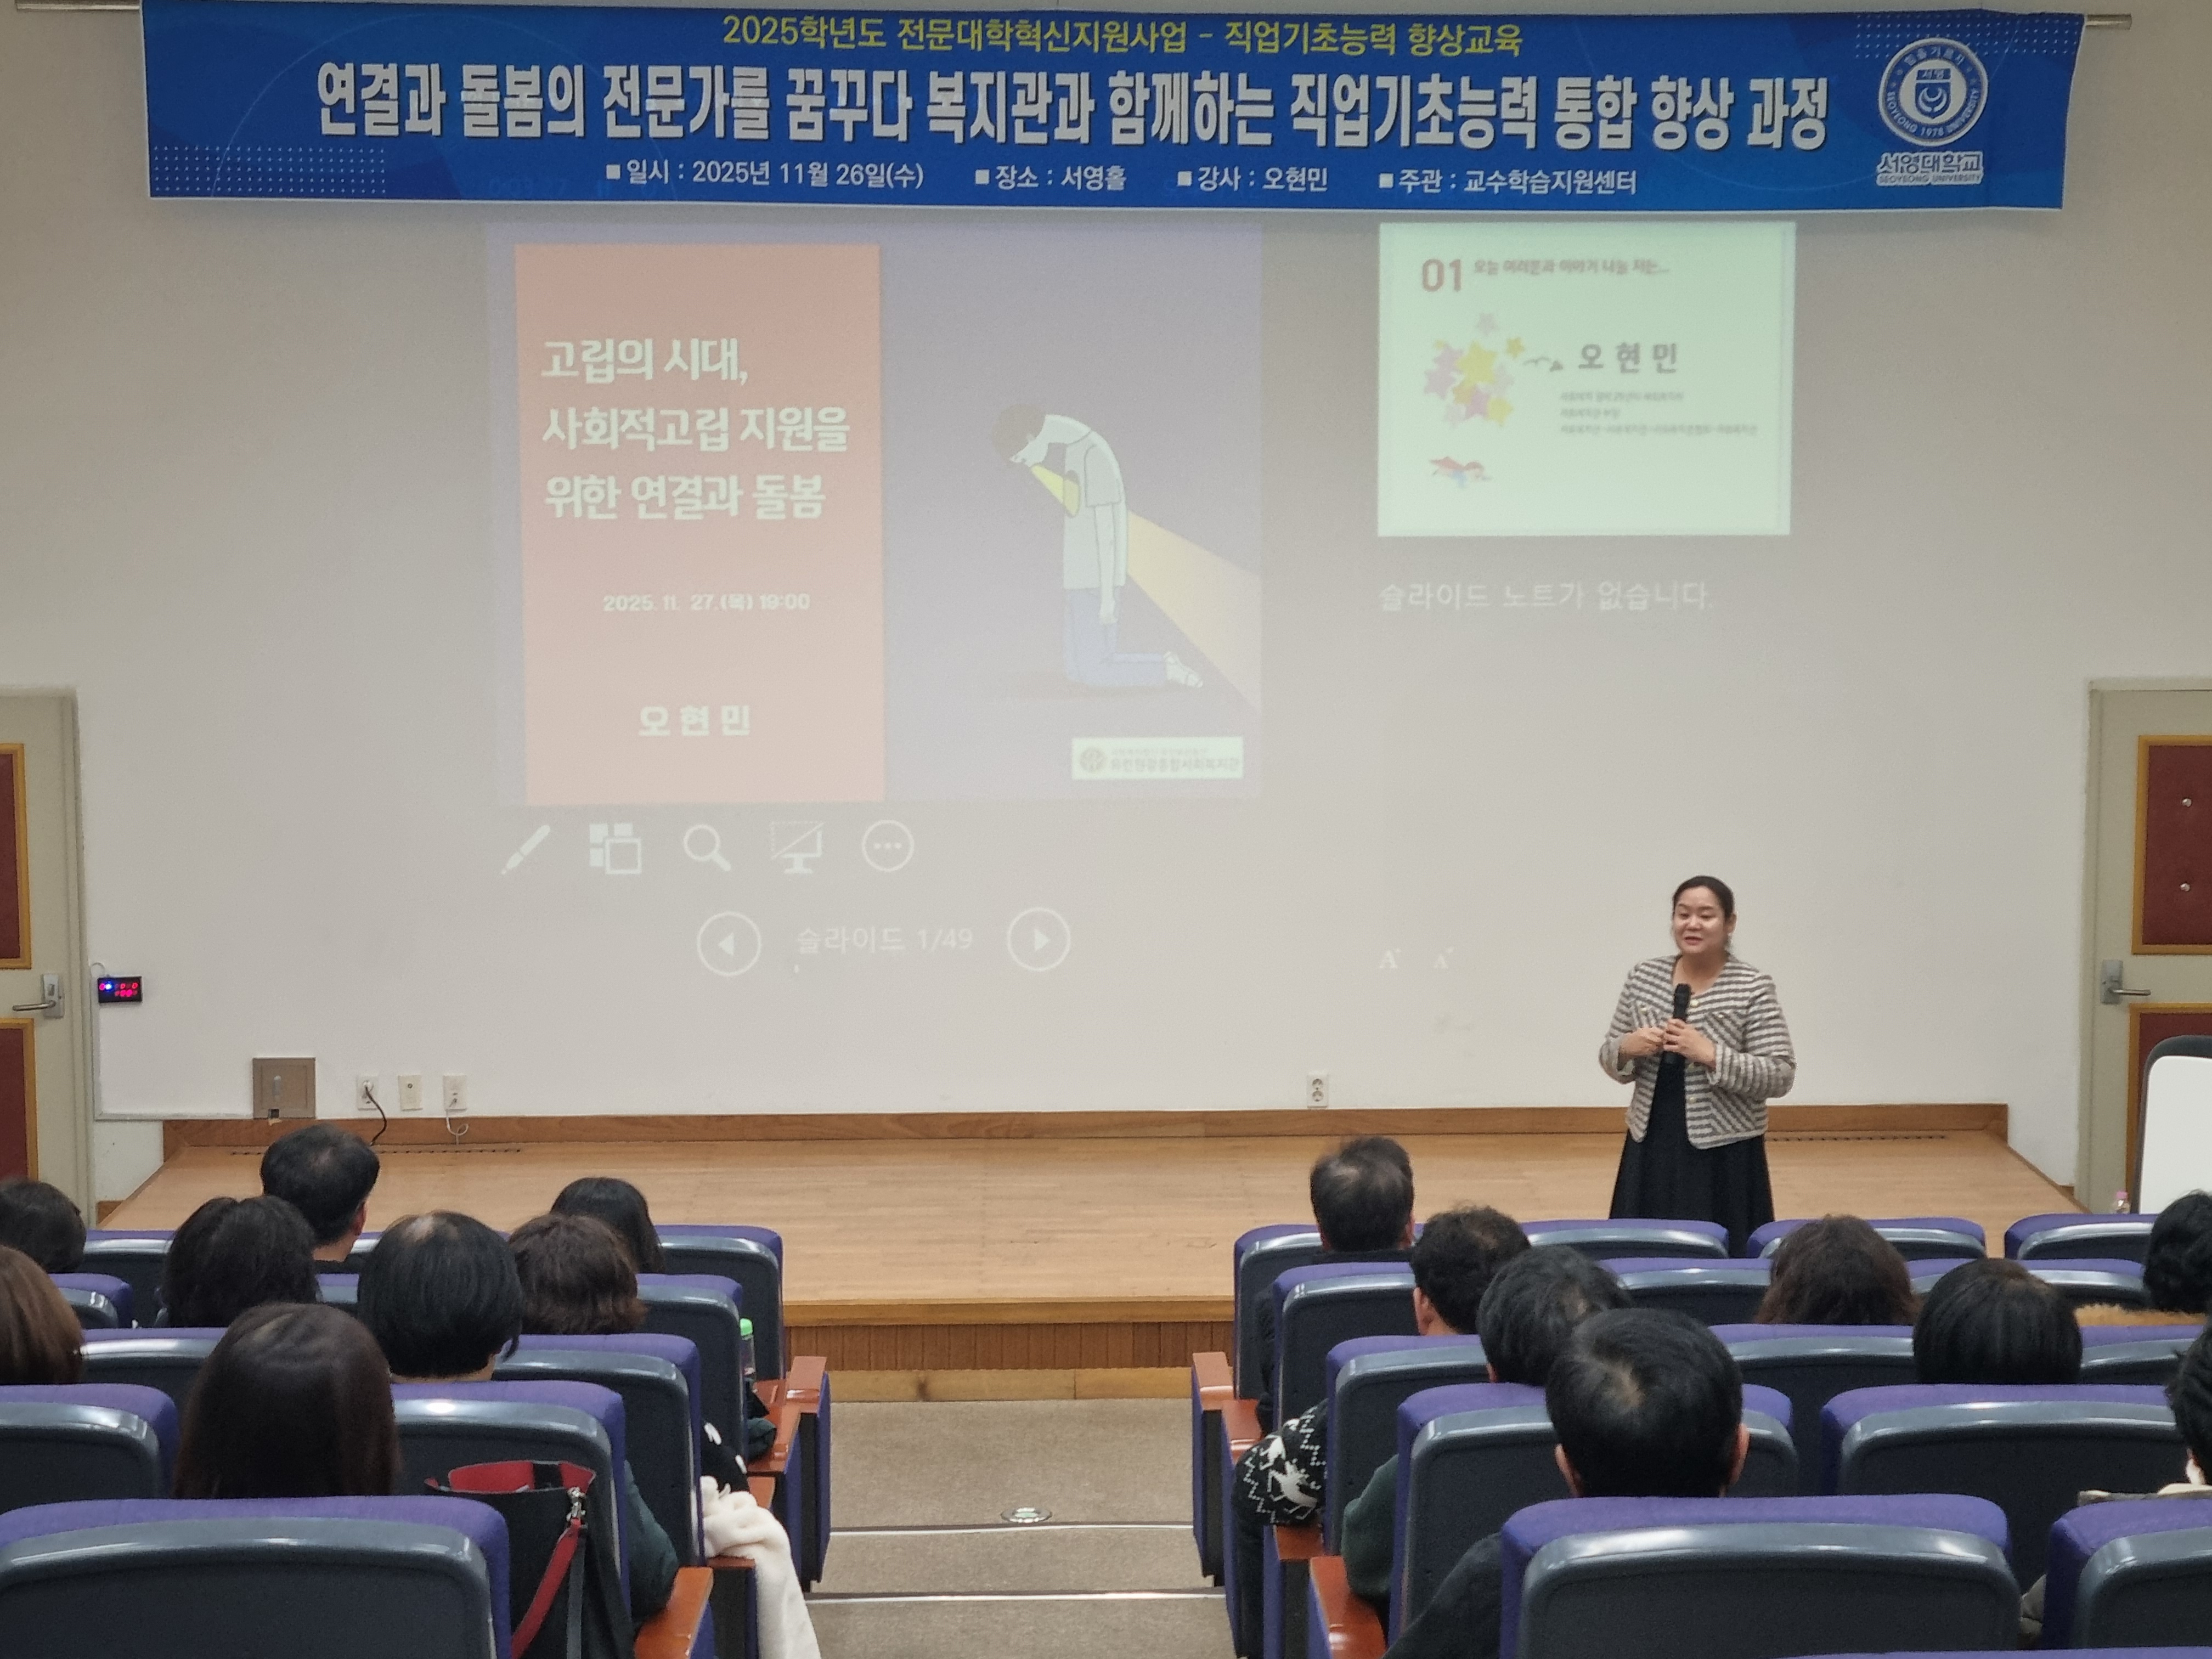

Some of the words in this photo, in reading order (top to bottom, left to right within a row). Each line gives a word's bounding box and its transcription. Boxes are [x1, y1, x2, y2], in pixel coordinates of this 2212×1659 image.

[723, 15, 887, 49] 2025학년도
[897, 18, 1186, 53] 전문대학혁신지원사업
[1224, 20, 1396, 56] 직업기초능력
[1408, 23, 1523, 57] 향상교육
[318, 62, 446, 136] 연결과
[460, 64, 584, 137] 돌봄의
[603, 65, 770, 139] 전문가를
[786, 68, 913, 142] 꿈꾸다
[927, 71, 1095, 144] 복지관과
[1108, 70, 1274, 145] 함께하는
[1290, 73, 1537, 149] 직업기초능력
[1554, 75, 1638, 150] 통합
[1651, 75, 1734, 150] 향상
[1747, 77, 1827, 150] 과정
[627, 159, 669, 184] 일시
[693, 160, 770, 185] 2025년
[780, 162, 828, 187] 11월
[836, 162, 924, 189] 26일(수)
[995, 165, 1039, 190] 장소
[1061, 165, 1126, 191] 서영홀
[1198, 166, 1242, 191] 강사
[1263, 167, 1327, 192] 오현민
[1878, 153, 1981, 174] 서영대학교
[1398, 169, 1443, 193] 주관
[1464, 170, 1637, 195] 교수학습지원센터
[1421, 258, 1462, 292] 01
[541, 338, 653, 384] 고립의
[664, 338, 748, 386] 시대,
[543, 407, 729, 452] 사회적고립
[740, 407, 850, 452] 지원을
[545, 475, 622, 520] 위한
[631, 475, 744, 521] 연결과
[752, 475, 826, 520] 돌봄
[1379, 583, 1489, 612] 슬라이드
[1502, 583, 1584, 610] 노트가
[1597, 581, 1713, 612] 없습니다.
[798, 926, 906, 954] 슬라이드
[918, 928, 973, 951] 1/49
